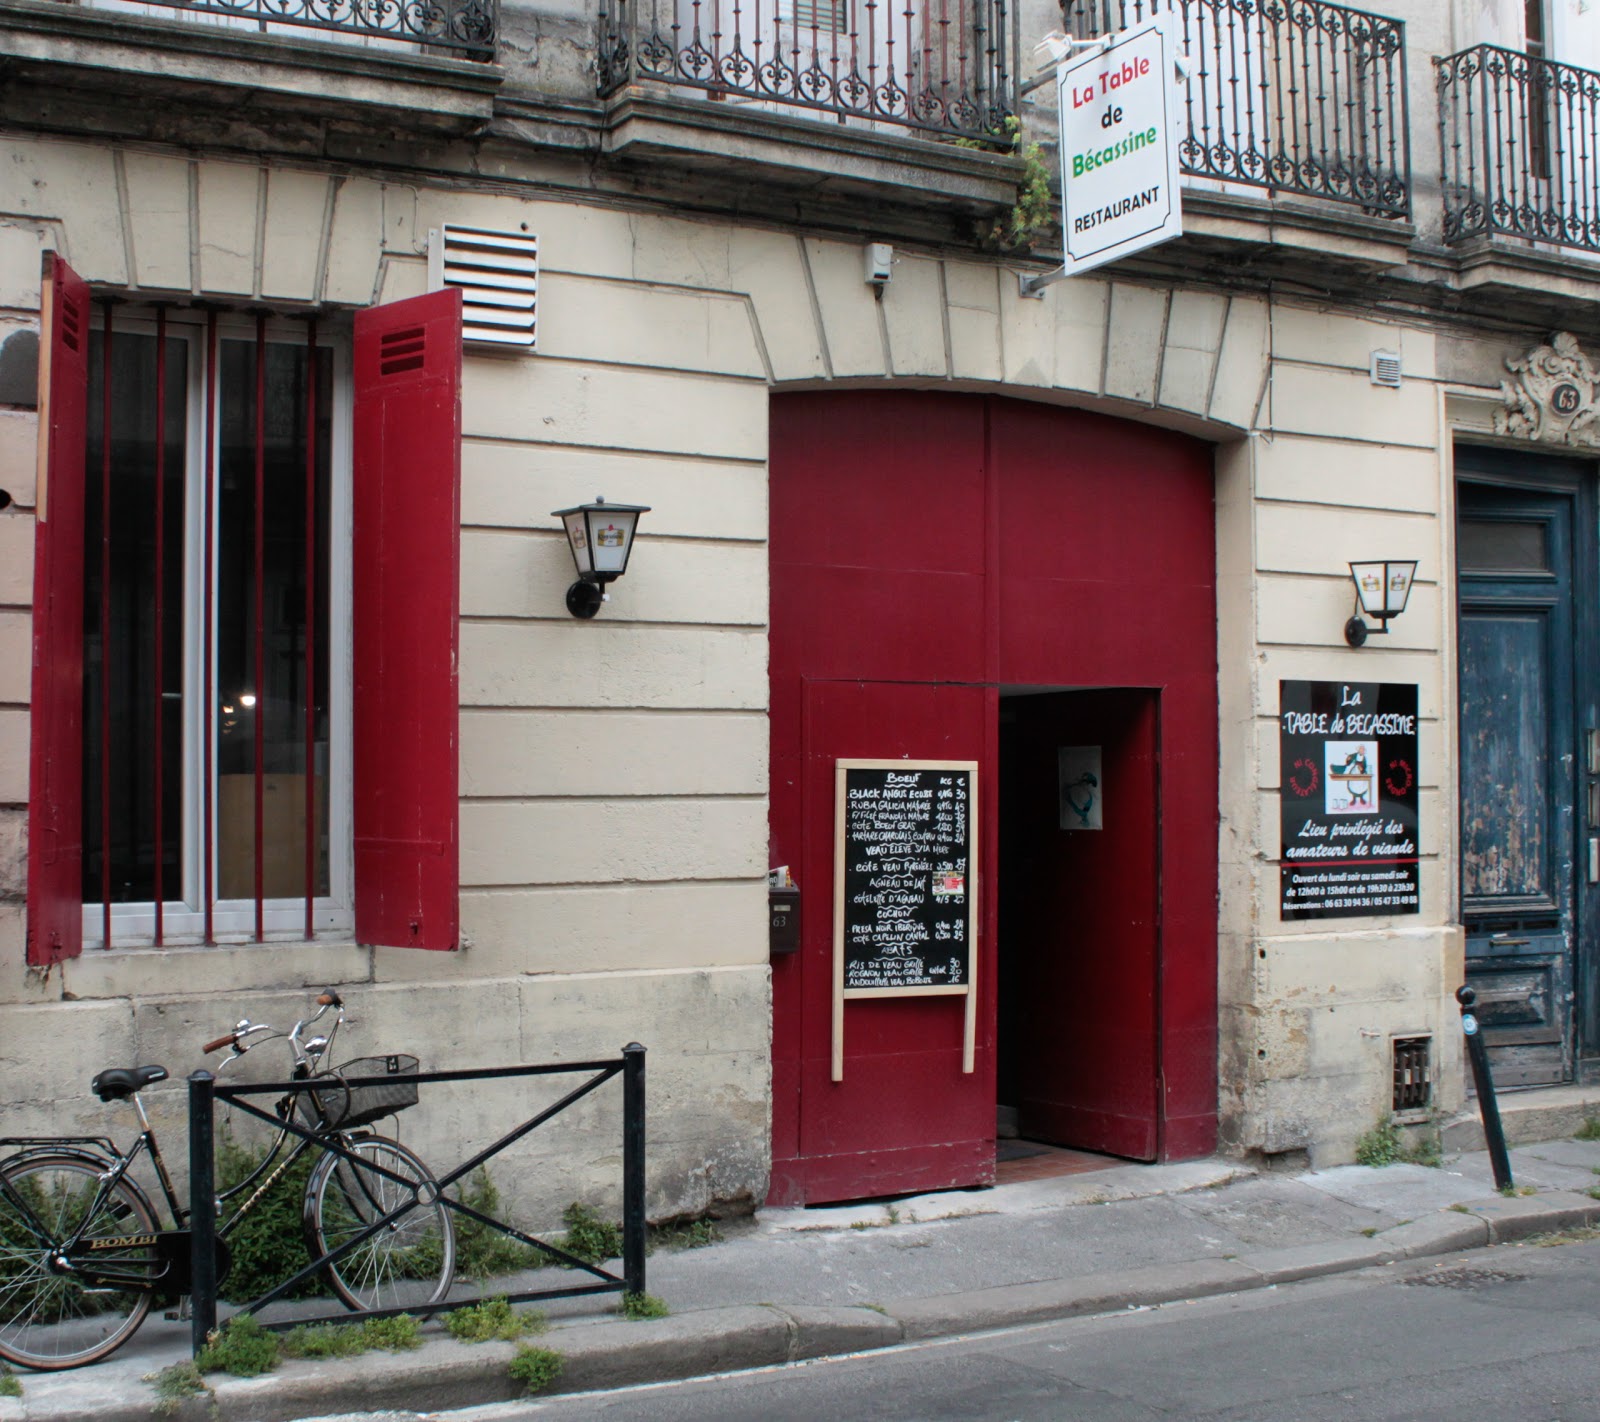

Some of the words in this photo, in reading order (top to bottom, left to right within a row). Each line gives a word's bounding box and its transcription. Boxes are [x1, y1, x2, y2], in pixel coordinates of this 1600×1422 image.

[1072, 84, 1094, 109] La
[1099, 56, 1150, 96] Table
[1101, 105, 1123, 129] de
[1072, 127, 1157, 178] Bécassine
[1074, 186, 1160, 234] RESTAURANT
[1559, 389, 1577, 410] 63
[1341, 685, 1362, 706] La
[1284, 711, 1328, 735] TABLE
[1330, 713, 1345, 734] de
[1346, 713, 1415, 735] BECASSINE
[886, 772, 922, 783] BOEUF
[850, 788, 880, 799] BLACK
[882, 789, 907, 800] ANGUS
[956, 789, 966, 800] 30
[1297, 819, 1327, 837] Lieu
[1329, 819, 1383, 840] privilégié
[1384, 819, 1403, 835] des
[865, 846, 887, 856] VEAU
[1286, 843, 1348, 858] amateurs
[1352, 840, 1368, 856] de
[1372, 839, 1414, 854] viande
[882, 863, 900, 872] VEAU
[869, 878, 900, 888] AGNEAU
[1292, 873, 1317, 883] Ouvert
[1318, 873, 1328, 882] du
[1328, 872, 1347, 882] lundi
[1347, 872, 1360, 881] soir
[1361, 873, 1370, 881] au
[1371, 870, 1396, 880] samedi
[1396, 870, 1409, 879] soir
[1286, 887, 1296, 896] de
[1297, 887, 1320, 896] 12h00
[1320, 886, 1326, 895] à
[1327, 885, 1348, 895] 15h00
[1349, 886, 1356, 894] et
[1356, 885, 1366, 893] de
[1367, 883, 1388, 893] 19h30
[1388, 883, 1393, 892] à
[1394, 882, 1415, 892] 23h30
[1325, 899, 1334, 908] 06
[1334, 898, 1343, 907] 63
[1343, 898, 1352, 907] 30
[1374, 896, 1382, 905] 05
[876, 909, 912, 919] COCHON
[772, 916, 786, 927] 63
[849, 960, 865, 969] RIS
[882, 961, 902, 969] VEAU
[883, 969, 902, 977] VEAU
